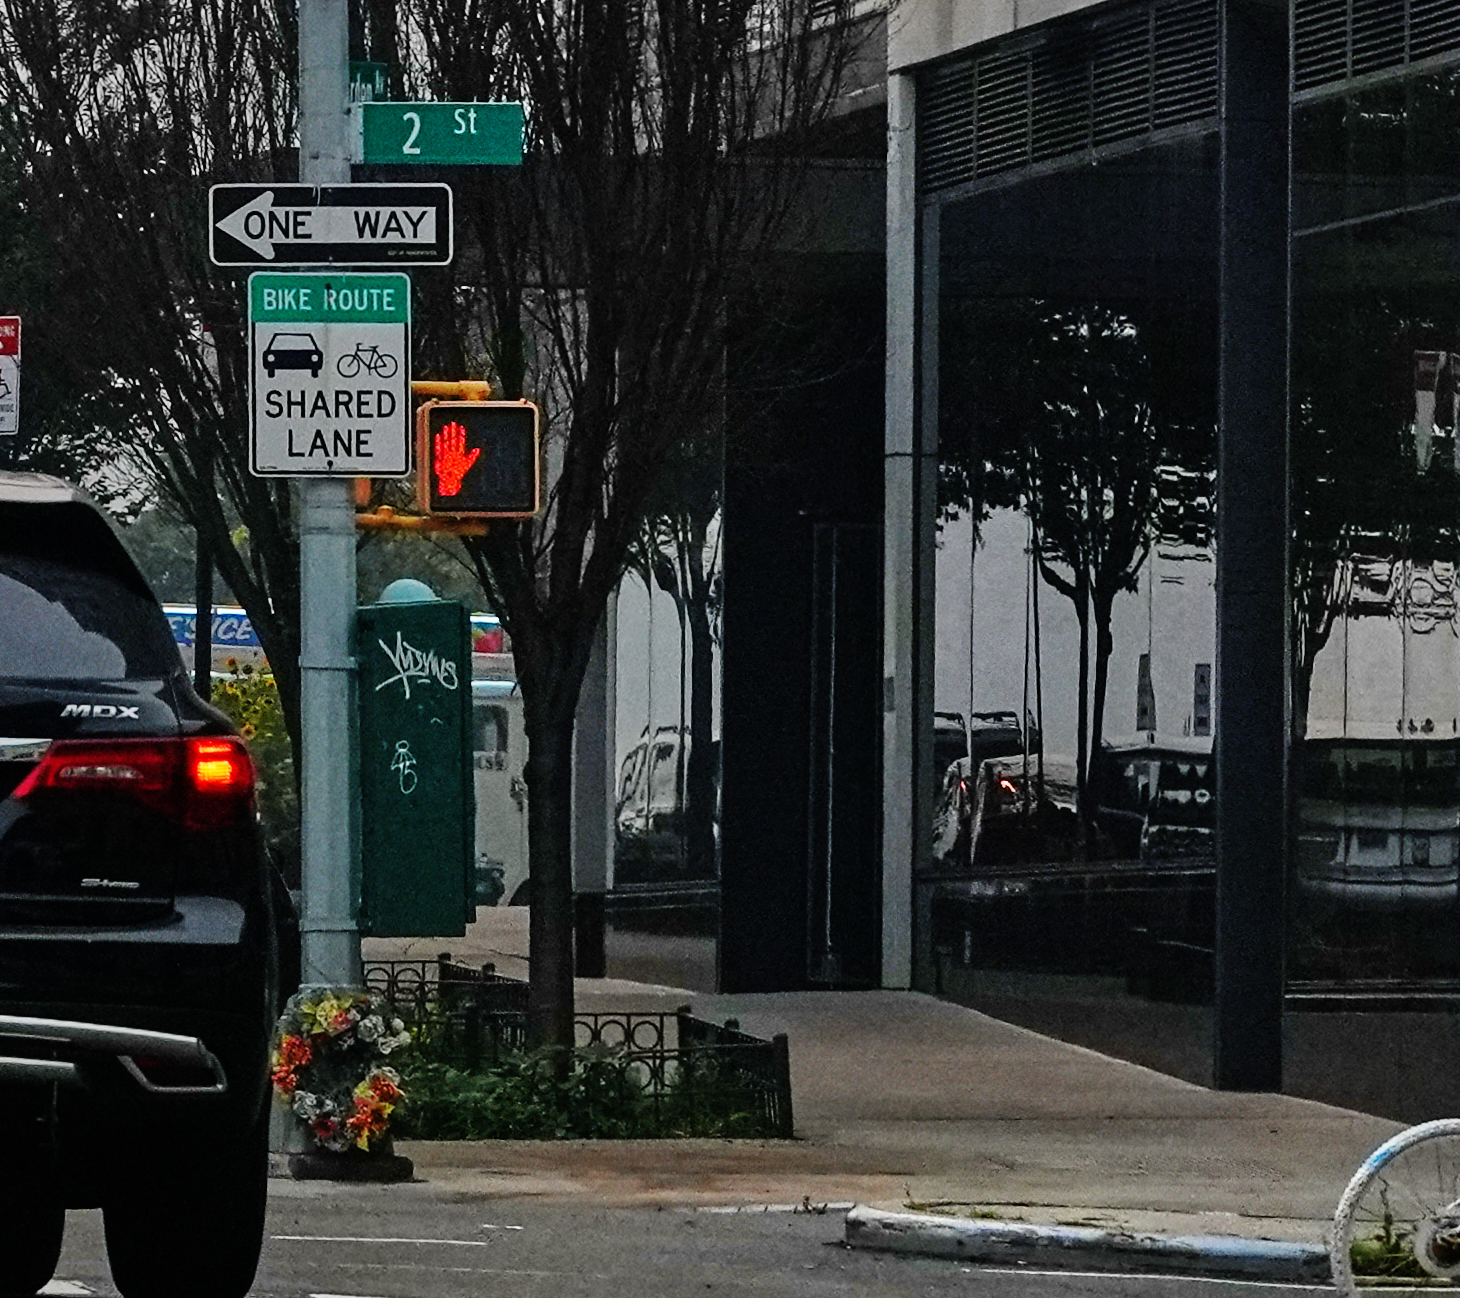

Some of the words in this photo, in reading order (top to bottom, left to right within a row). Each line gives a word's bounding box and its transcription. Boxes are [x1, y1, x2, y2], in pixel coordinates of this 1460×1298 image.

[402, 111, 421, 154] 2
[454, 107, 477, 134] St
[243, 210, 313, 240] ONE
[353, 210, 428, 240] WAY
[263, 288, 312, 312] BIKE
[323, 288, 396, 312] ROUTE
[264, 389, 397, 419] SHARED
[288, 428, 374, 458] LANE
[60, 704, 139, 719] MDX
